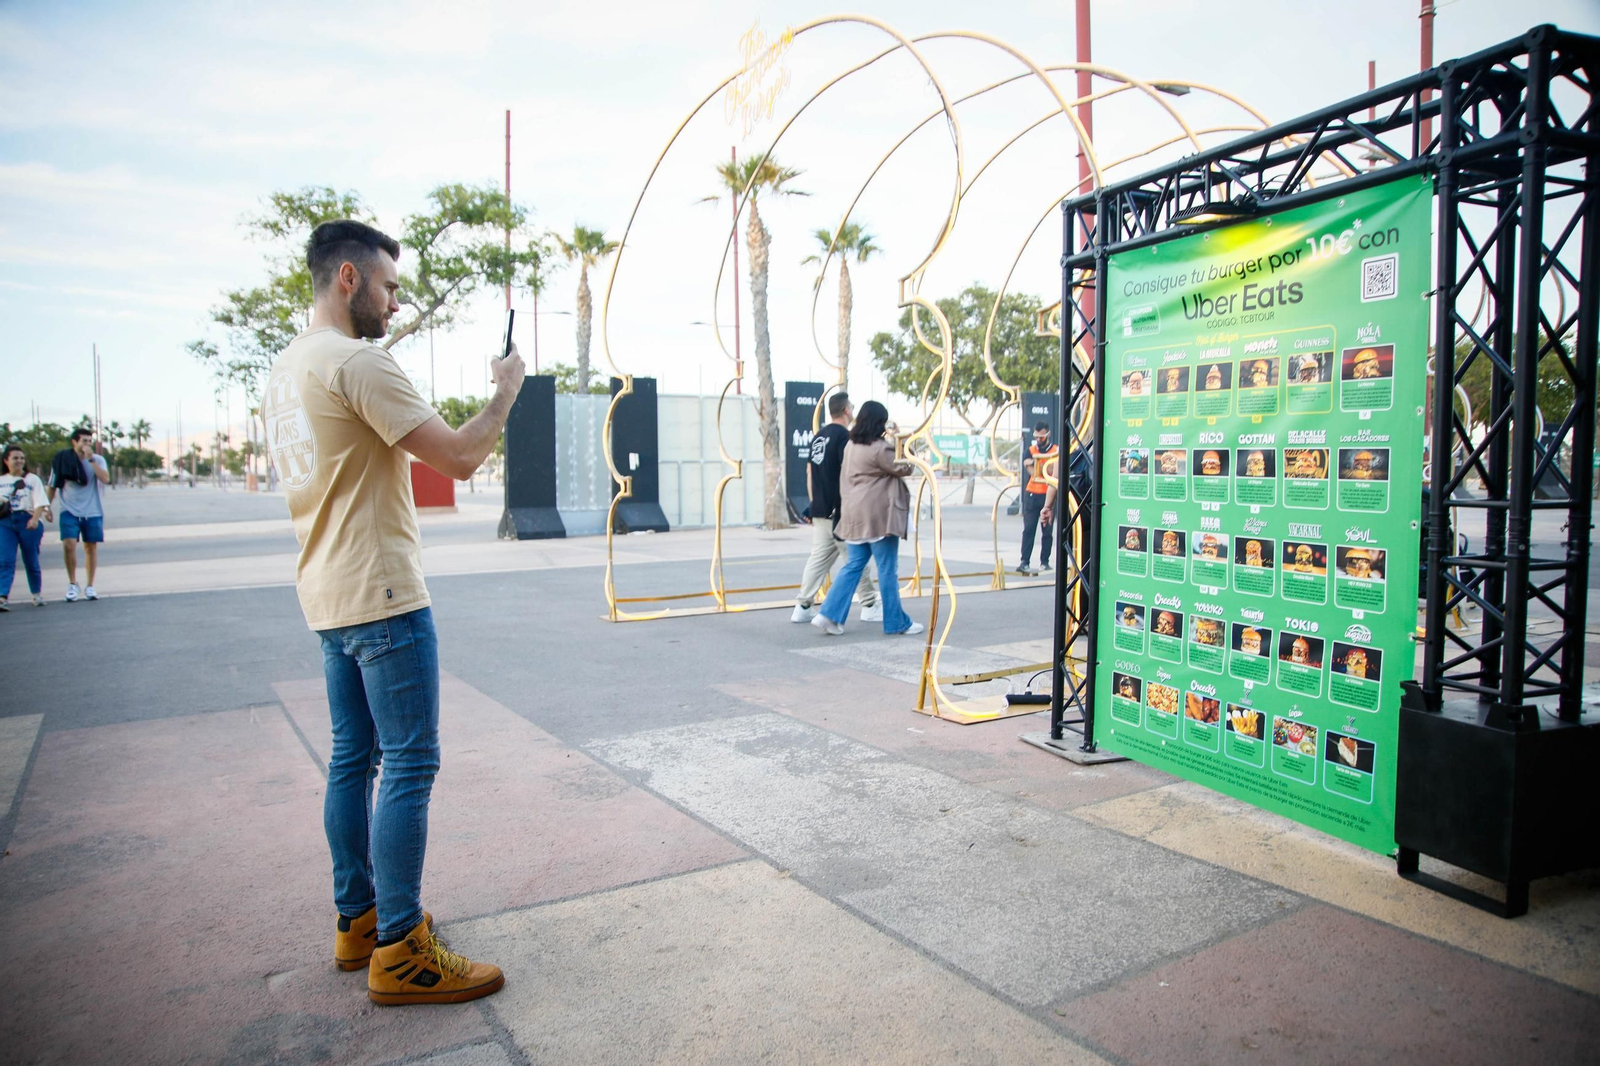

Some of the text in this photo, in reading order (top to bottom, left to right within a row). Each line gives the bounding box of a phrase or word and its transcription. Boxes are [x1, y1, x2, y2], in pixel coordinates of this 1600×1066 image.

[1124, 274, 1188, 298] Consigue
[1190, 268, 1206, 284] tu
[1208, 256, 1263, 280] burger
[1268, 247, 1303, 269] por
[1359, 226, 1399, 251] con
[1182, 280, 1304, 321] Uber Eats
[1240, 311, 1275, 325] TCBTOUR
[1294, 335, 1330, 350] GUINNESS
[796, 396, 812, 405] ODS
[271, 412, 300, 445] VANS
[1198, 432, 1224, 444] RICO
[1238, 432, 1275, 445] GOTTAN
[1344, 525, 1378, 544] SOUL
[1284, 616, 1318, 633] TOKIO
[1114, 658, 1140, 674] GODEO
